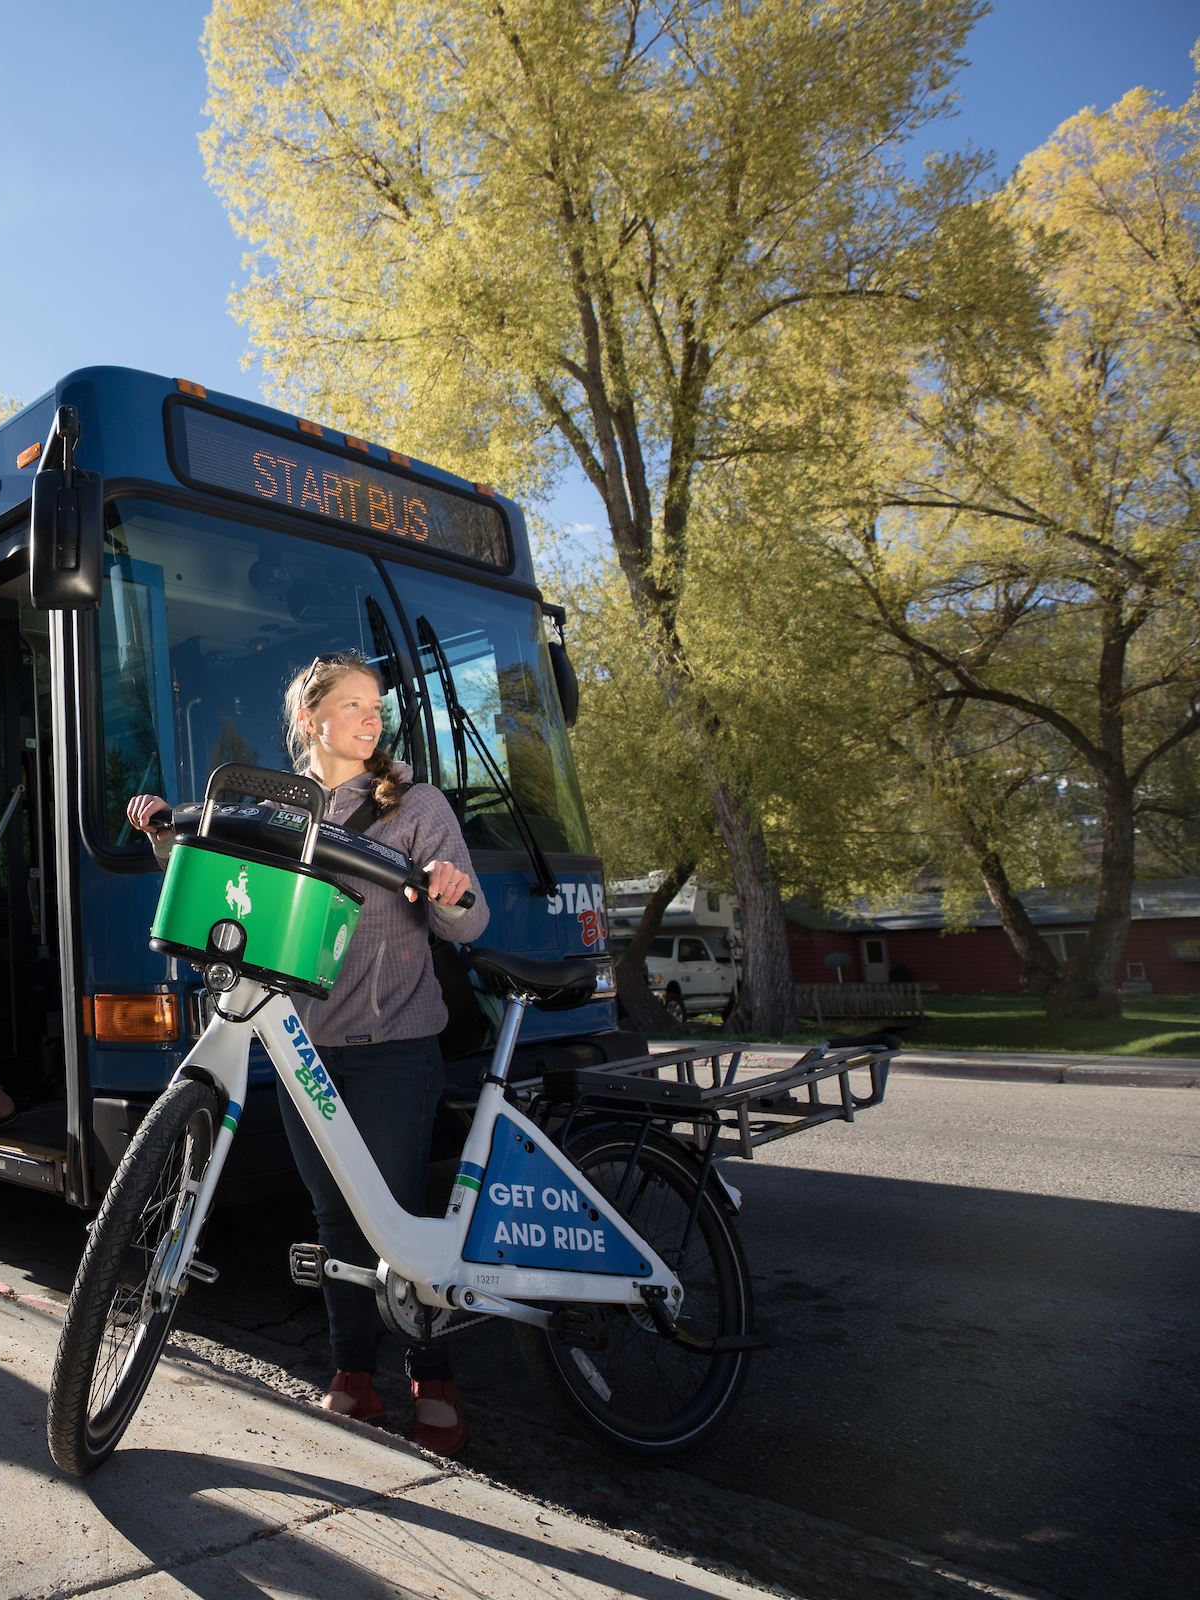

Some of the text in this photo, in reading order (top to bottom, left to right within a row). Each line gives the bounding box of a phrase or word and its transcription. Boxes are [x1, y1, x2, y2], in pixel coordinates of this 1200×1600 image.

[253, 451, 430, 541] START BUS
[276, 811, 306, 824] ECW
[283, 1015, 338, 1099] START
[488, 1183, 579, 1213] GET ON
[494, 1221, 606, 1253] AND RIDE
[476, 1275, 500, 1285] 13277
